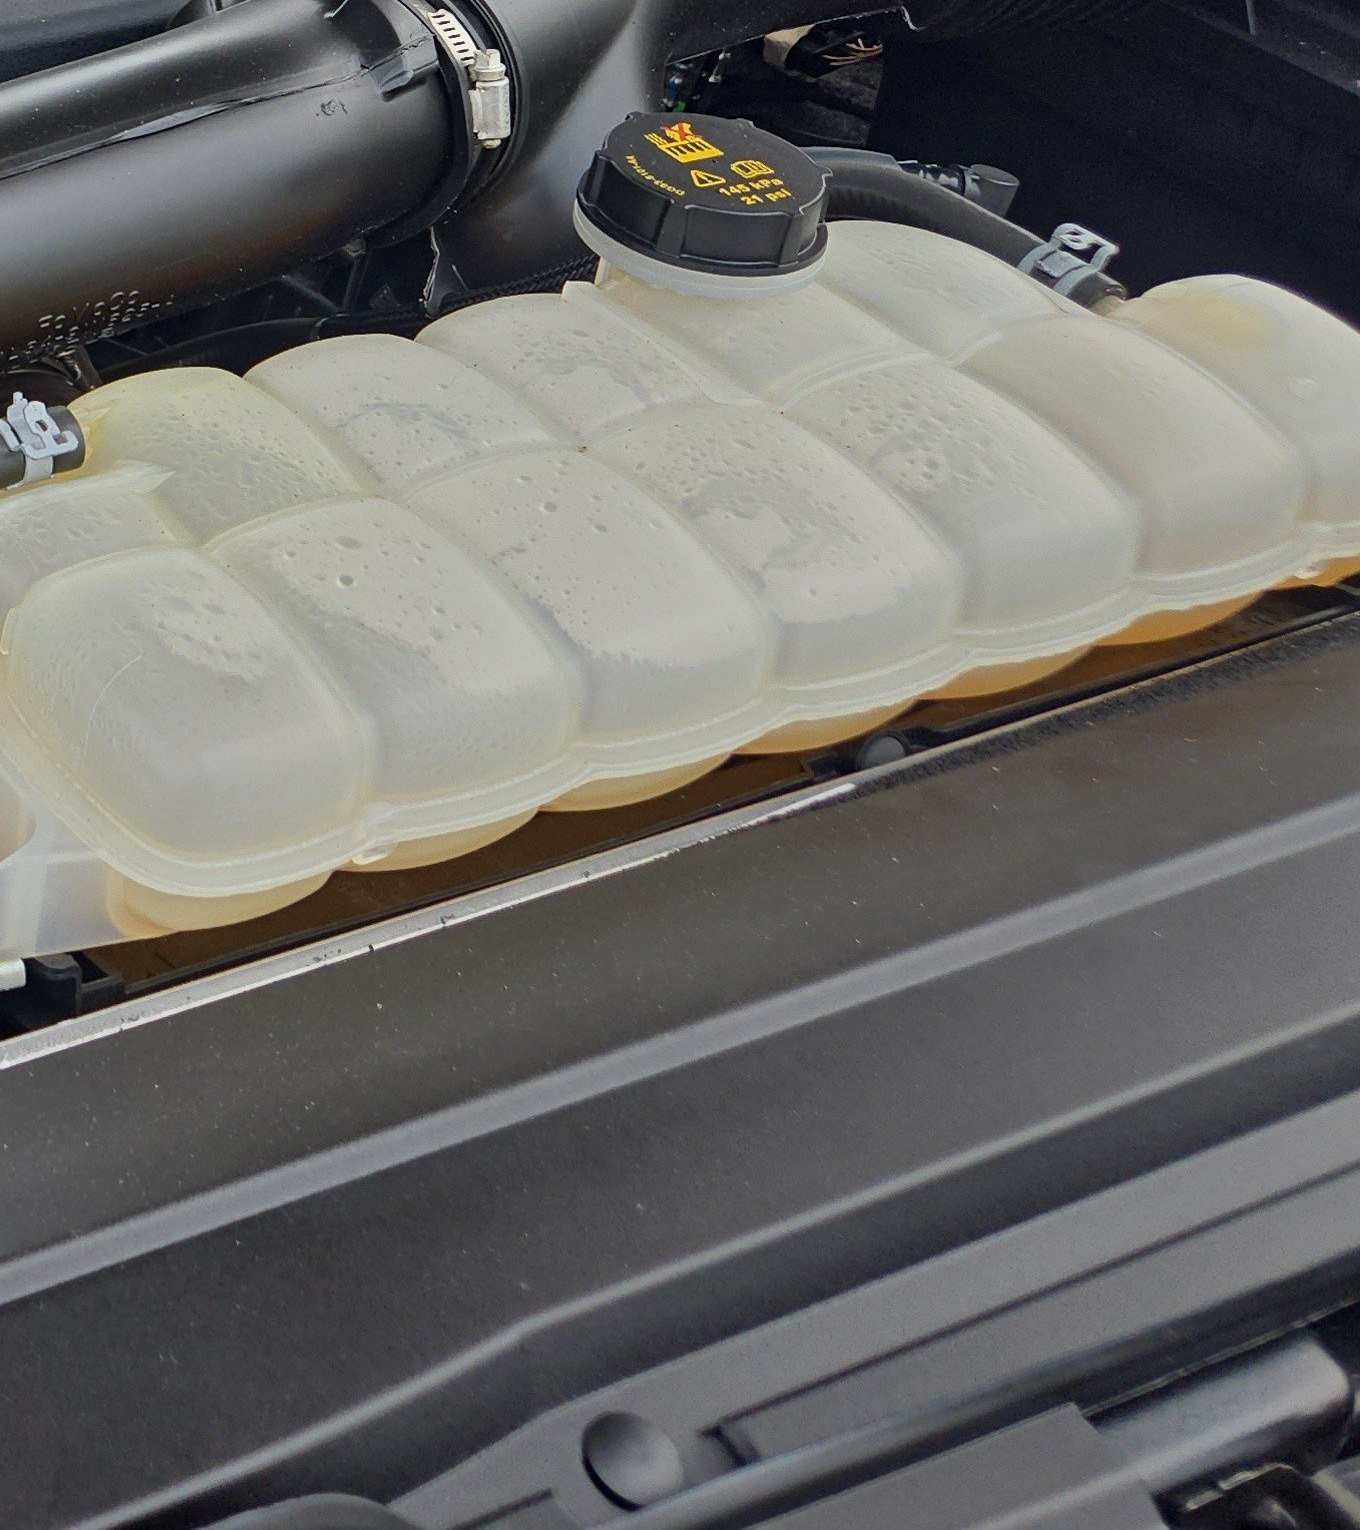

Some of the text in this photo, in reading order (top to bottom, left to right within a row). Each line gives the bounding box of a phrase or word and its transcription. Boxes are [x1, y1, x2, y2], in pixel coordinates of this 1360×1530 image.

[718, 178, 784, 196] 145 kPa
[740, 188, 792, 206] 21 psi
